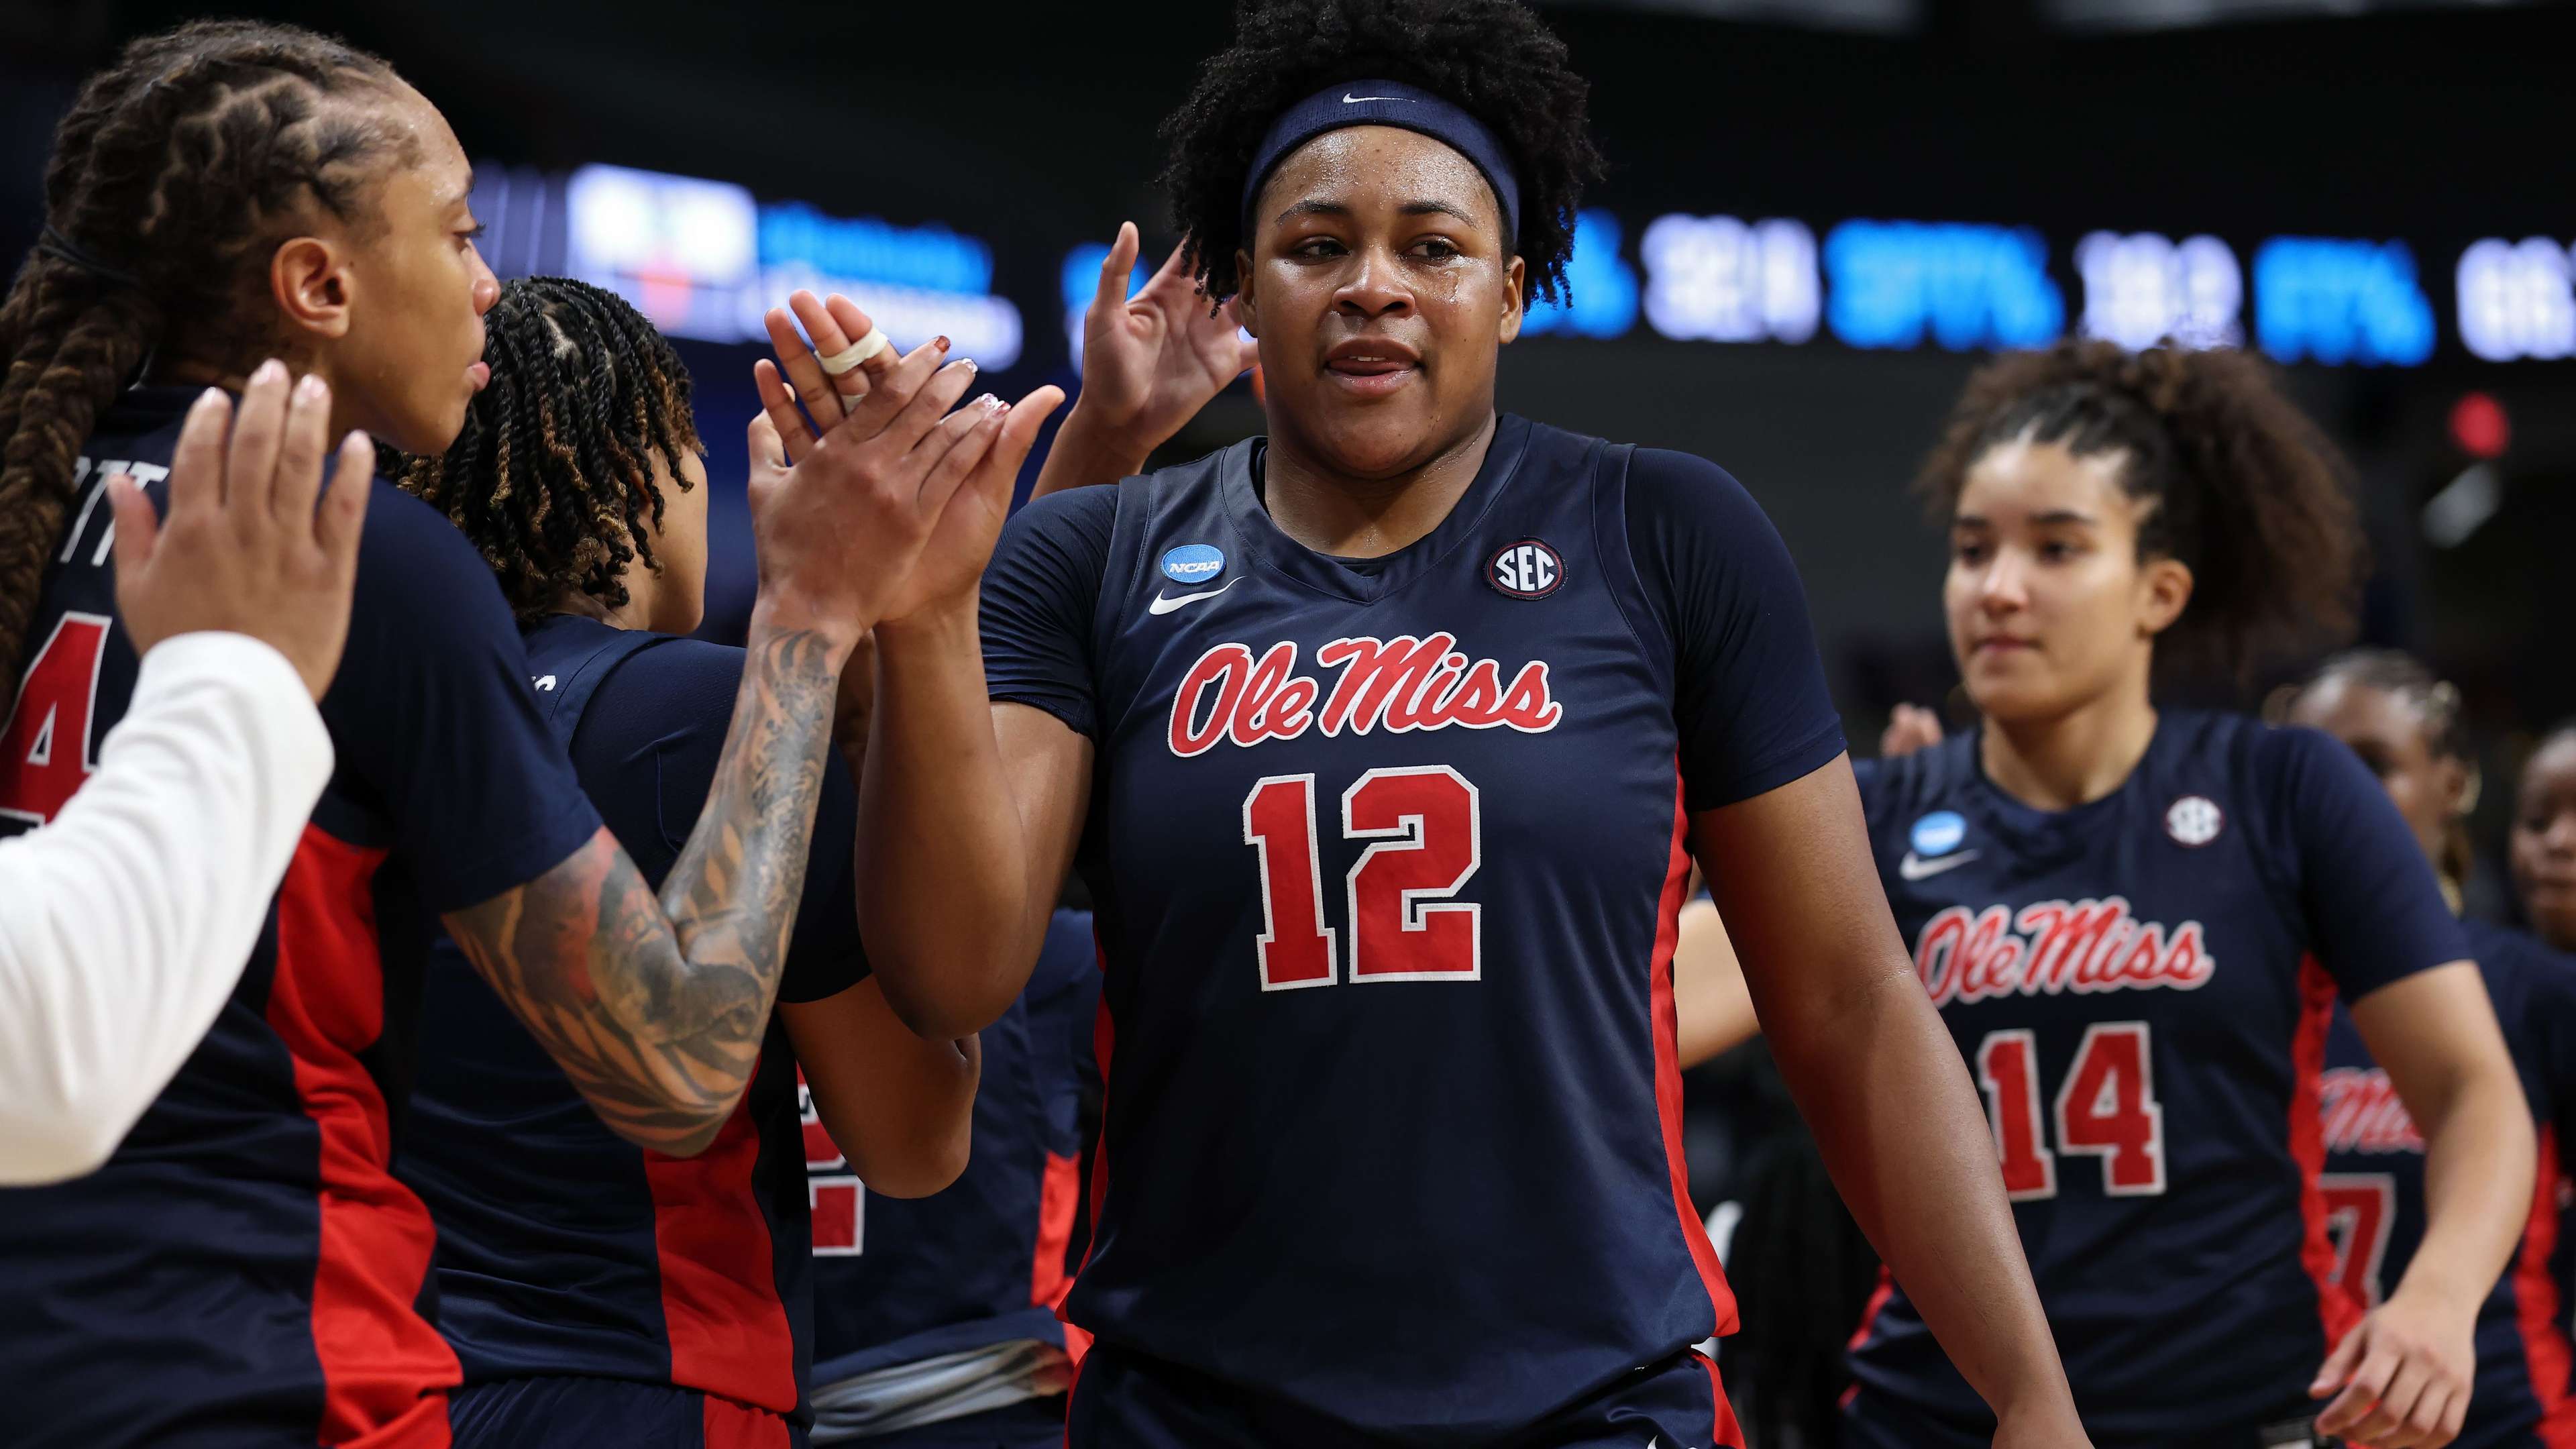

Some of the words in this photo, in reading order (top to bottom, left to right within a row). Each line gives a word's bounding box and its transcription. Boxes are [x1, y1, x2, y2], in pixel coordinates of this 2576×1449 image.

[1169, 560, 1220, 574] NCAA
[1495, 545, 1555, 591] SEC
[1168, 641, 1319, 757] Ole
[1316, 631, 1563, 735] Miss
[1242, 764, 1481, 992] 12
[1915, 906, 2027, 1009] Ole
[2016, 896, 2216, 996] Miss
[1976, 1020, 2167, 1201] 14
